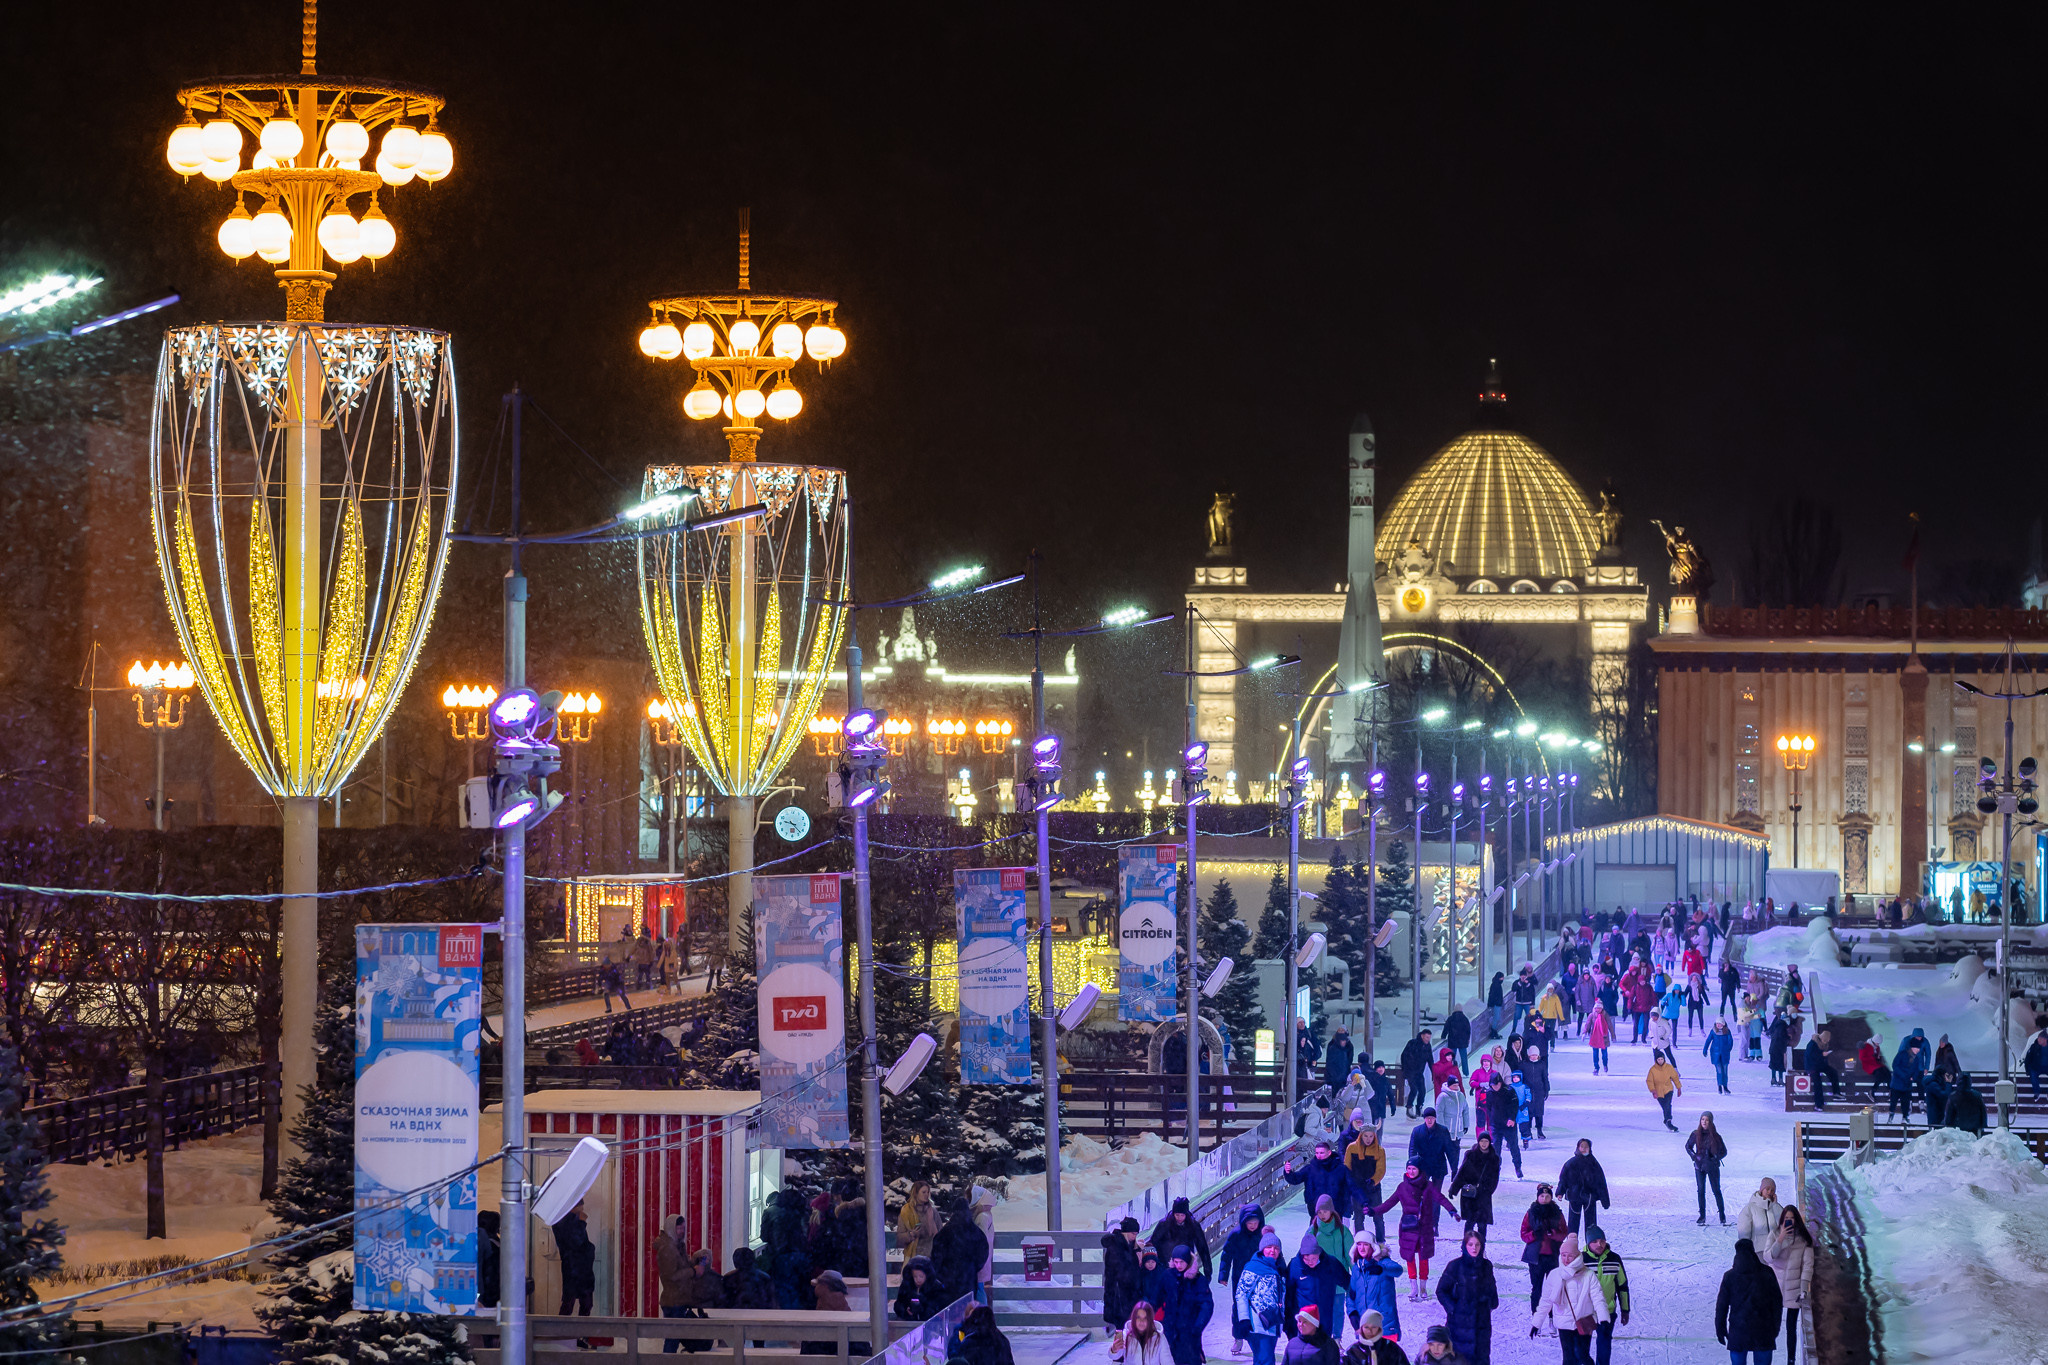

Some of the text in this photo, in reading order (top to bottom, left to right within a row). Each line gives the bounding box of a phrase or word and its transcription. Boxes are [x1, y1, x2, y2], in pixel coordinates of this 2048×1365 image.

[1122, 928, 1172, 939] CITROËN
[445, 953, 475, 962] ВДНХ
[360, 1106, 468, 1117] СКАЗОЧНАЯ ЗИМА
[390, 1120, 442, 1131] НА ВДНХ
